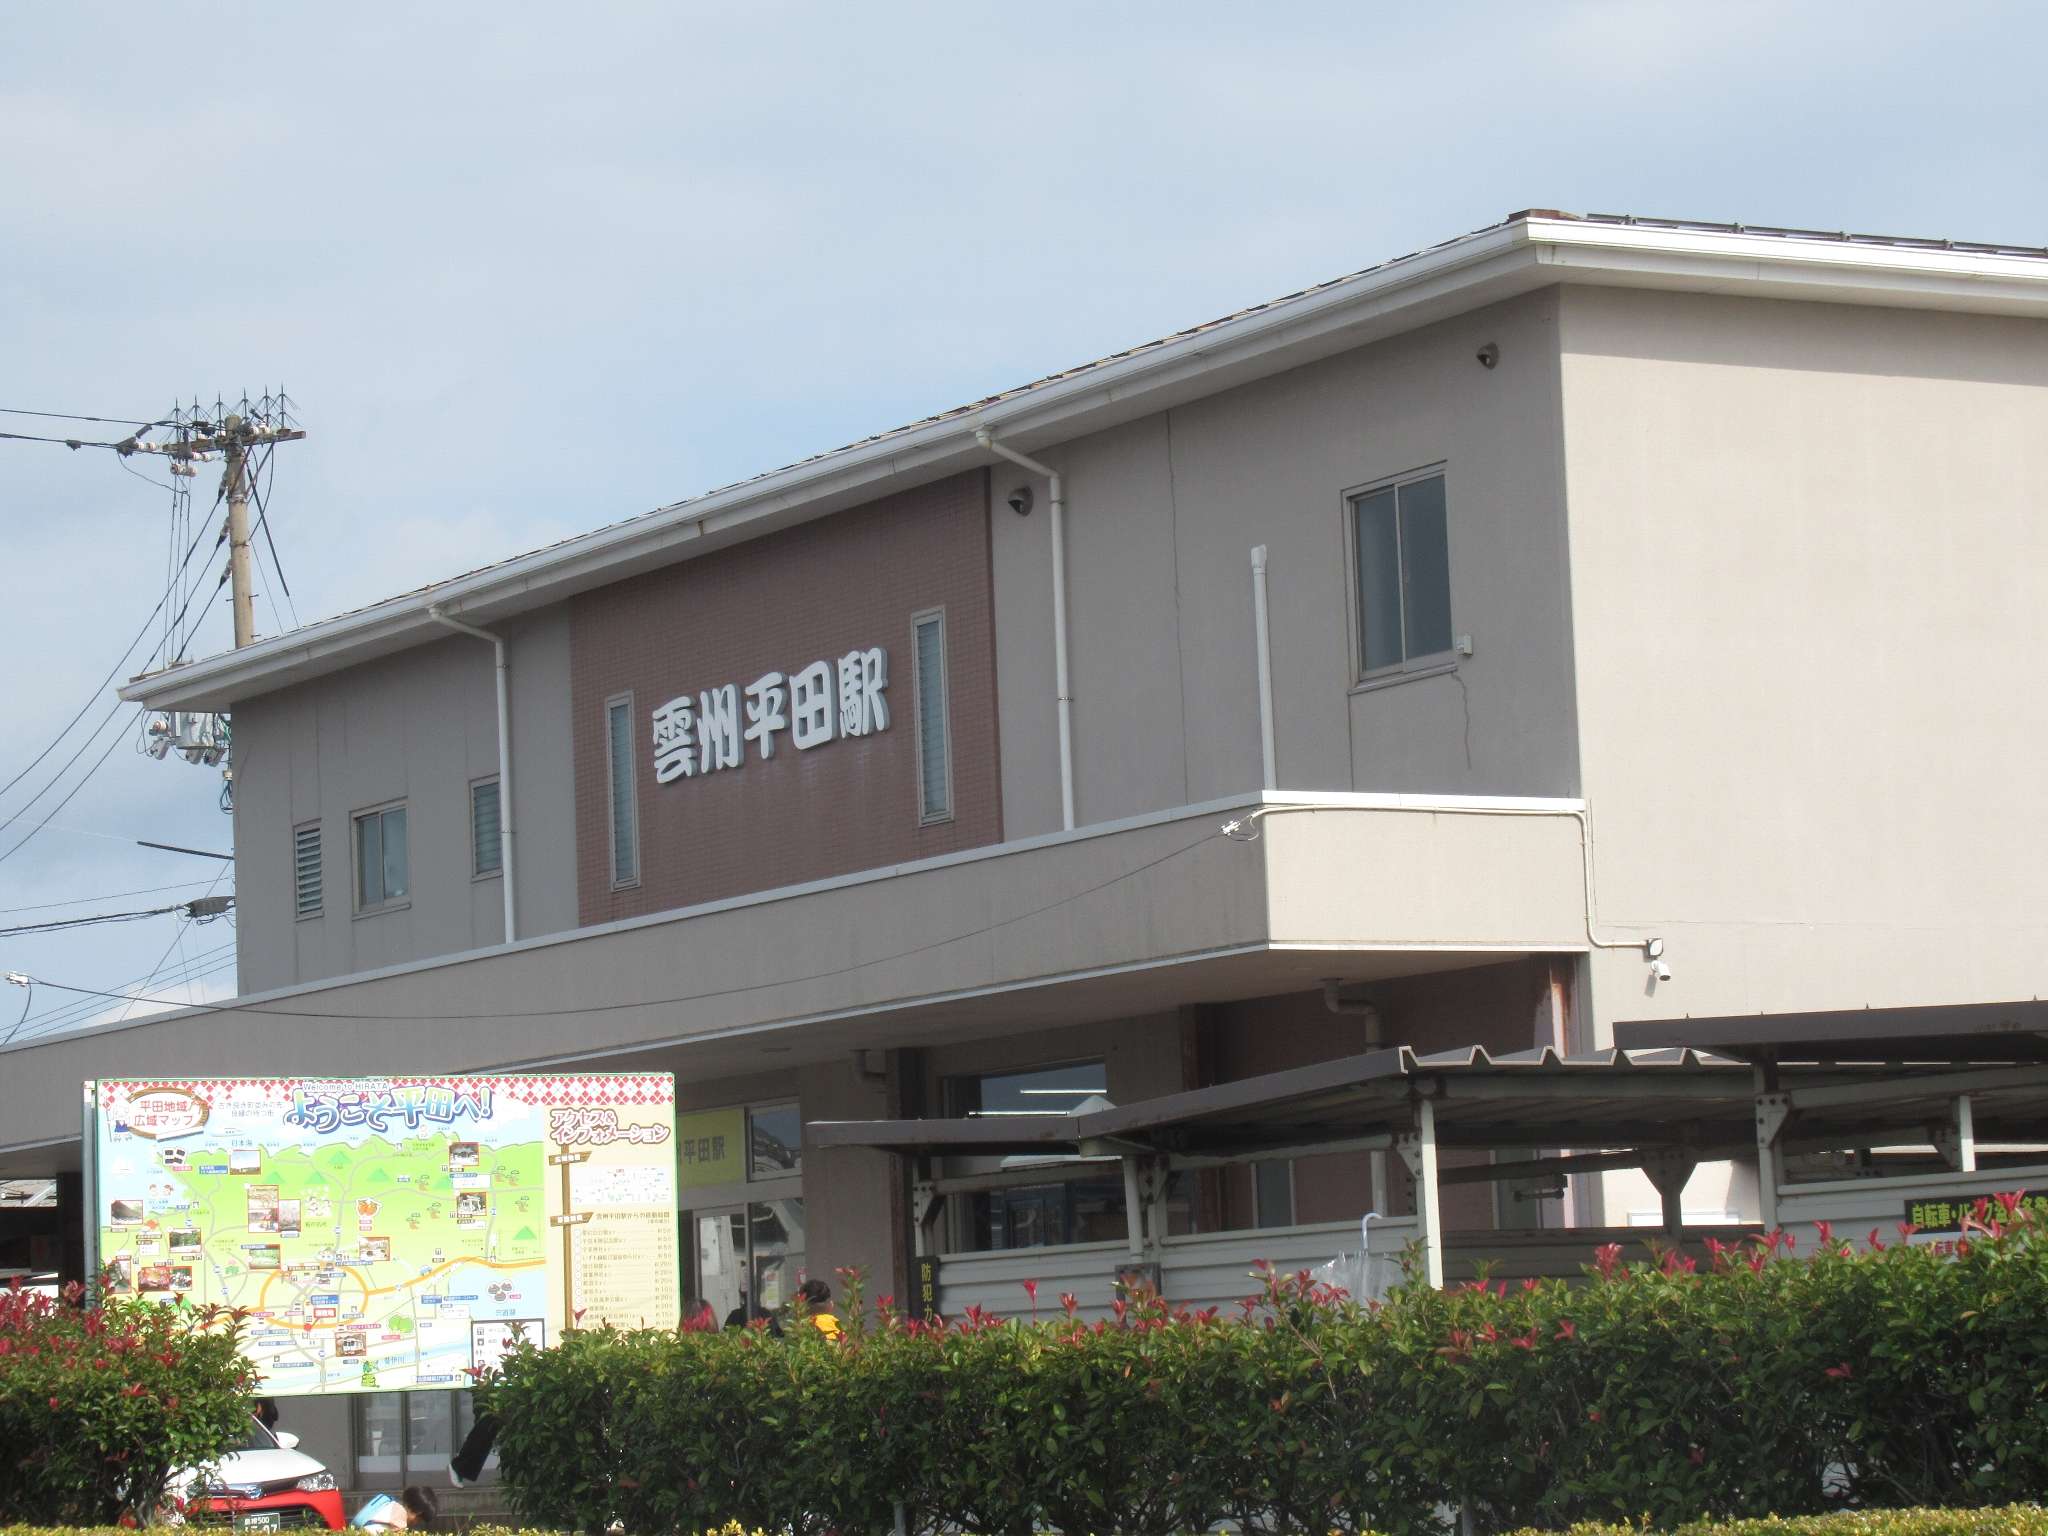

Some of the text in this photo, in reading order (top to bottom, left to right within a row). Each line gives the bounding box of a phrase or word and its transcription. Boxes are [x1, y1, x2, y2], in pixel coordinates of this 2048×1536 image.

[652, 647, 888, 784] 雲州平田駅
[304, 1082, 342, 1091] Welcome
[355, 1081, 388, 1090] HIRATA
[140, 1100, 189, 1113] 平田地域
[551, 1122, 671, 1145] インフォメーション
[678, 1136, 725, 1164] 平田駅
